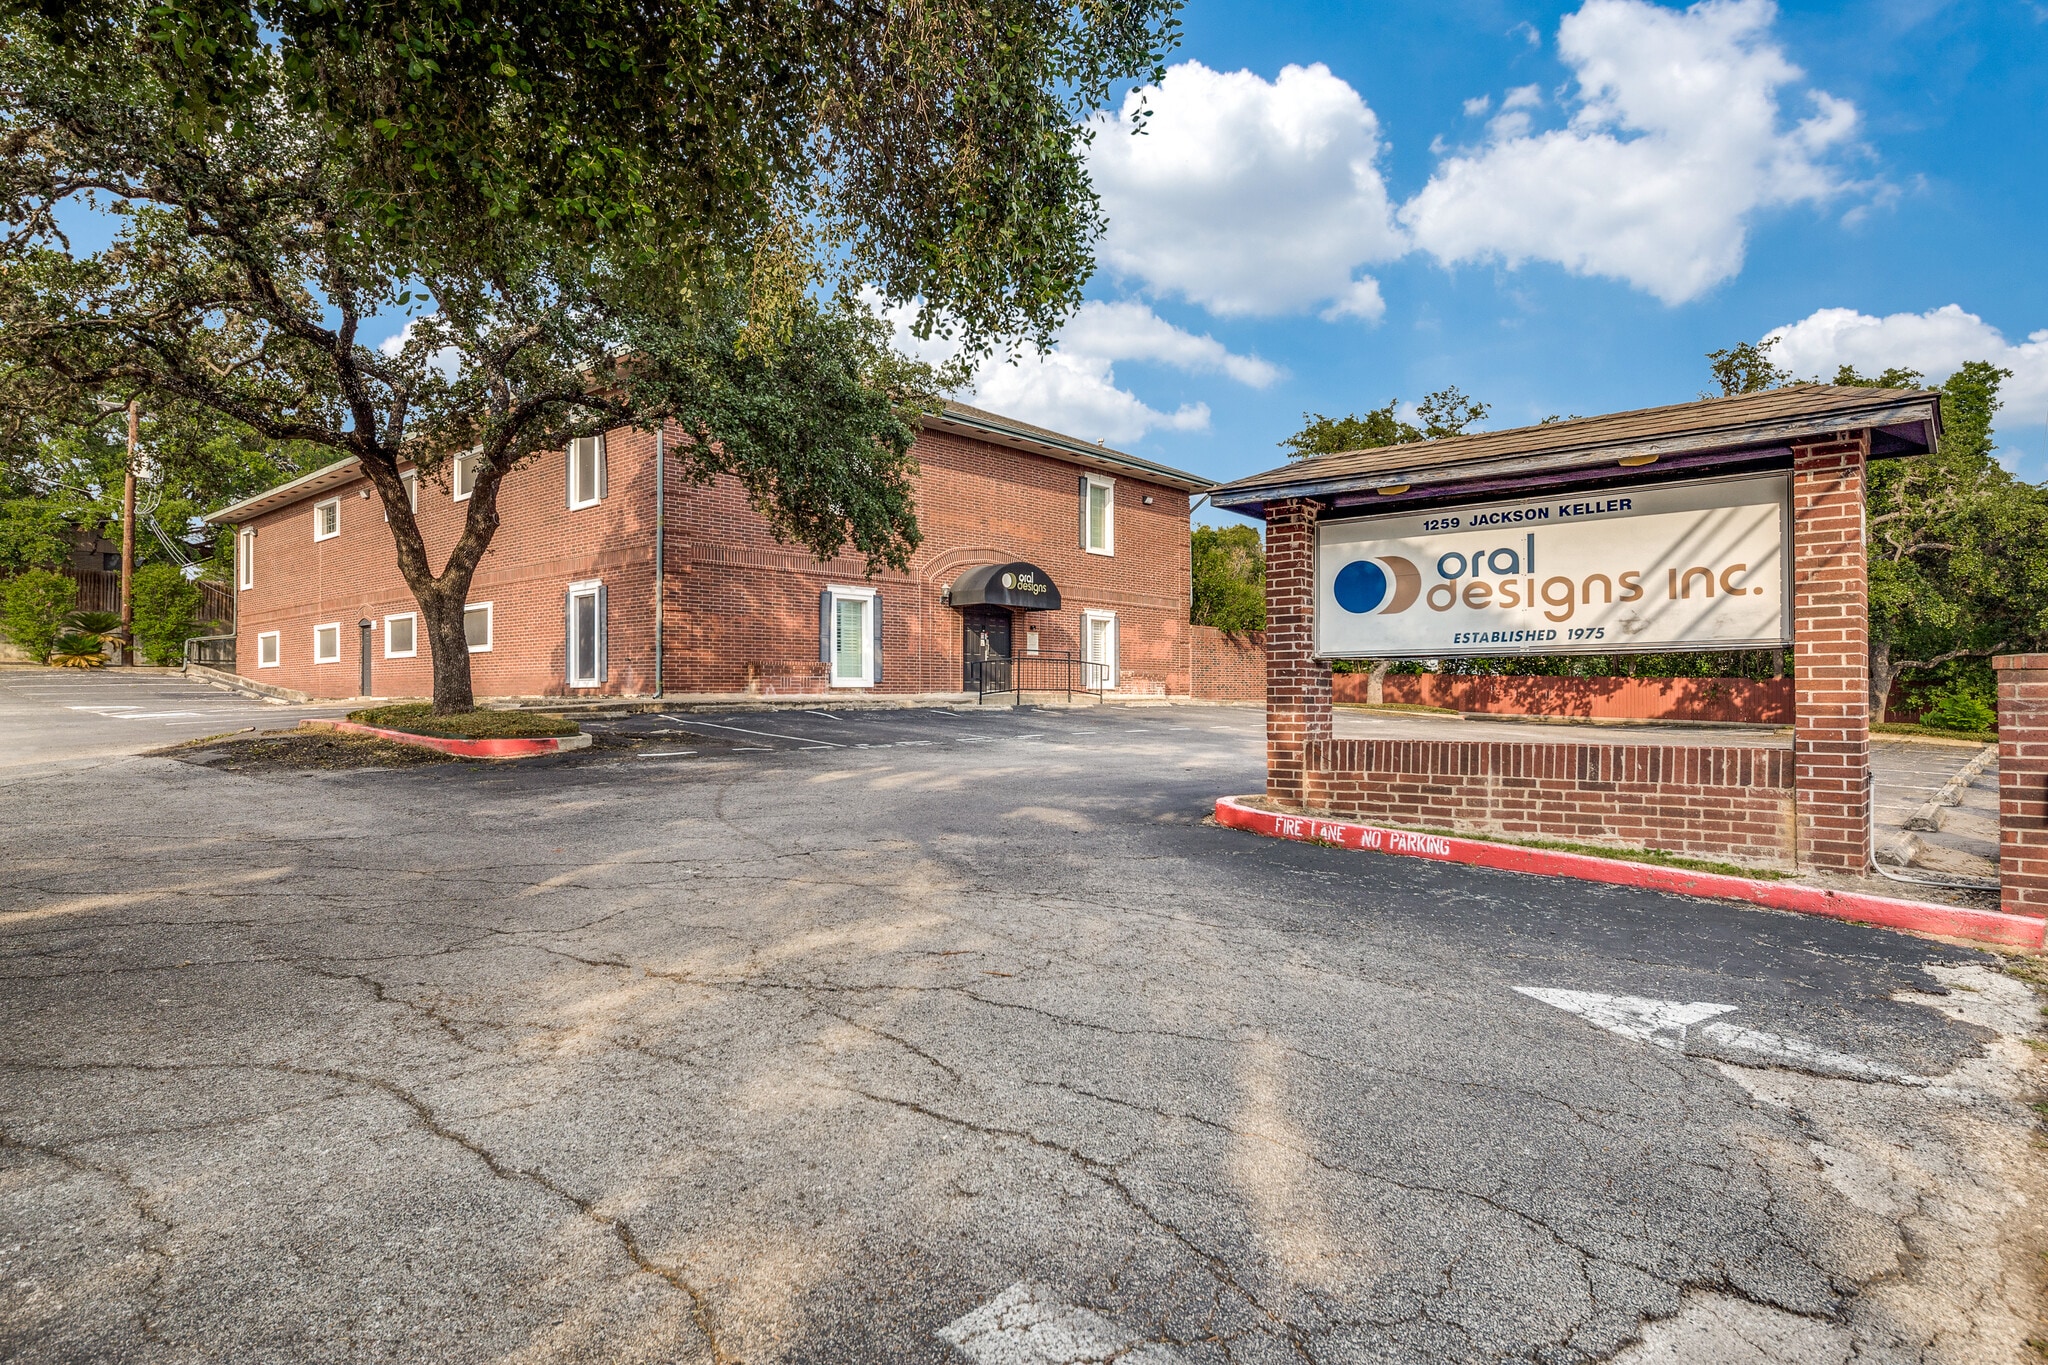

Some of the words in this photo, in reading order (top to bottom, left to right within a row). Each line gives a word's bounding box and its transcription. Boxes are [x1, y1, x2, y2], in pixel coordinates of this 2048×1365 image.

[1423, 517, 1460, 531] 1259
[1469, 507, 1550, 527] JACKSON
[1558, 498, 1633, 518] KELLER
[1437, 532, 1535, 580] oral
[1017, 582, 1047, 595] designs
[1018, 572, 1034, 583] oral
[1426, 570, 1644, 623] designs
[1453, 629, 1557, 644] ESTABLISHED
[1567, 627, 1605, 640] 1975
[1275, 817, 1304, 837] FIRE
[1361, 829, 1381, 848] NO
[1389, 832, 1450, 856] PARKING
